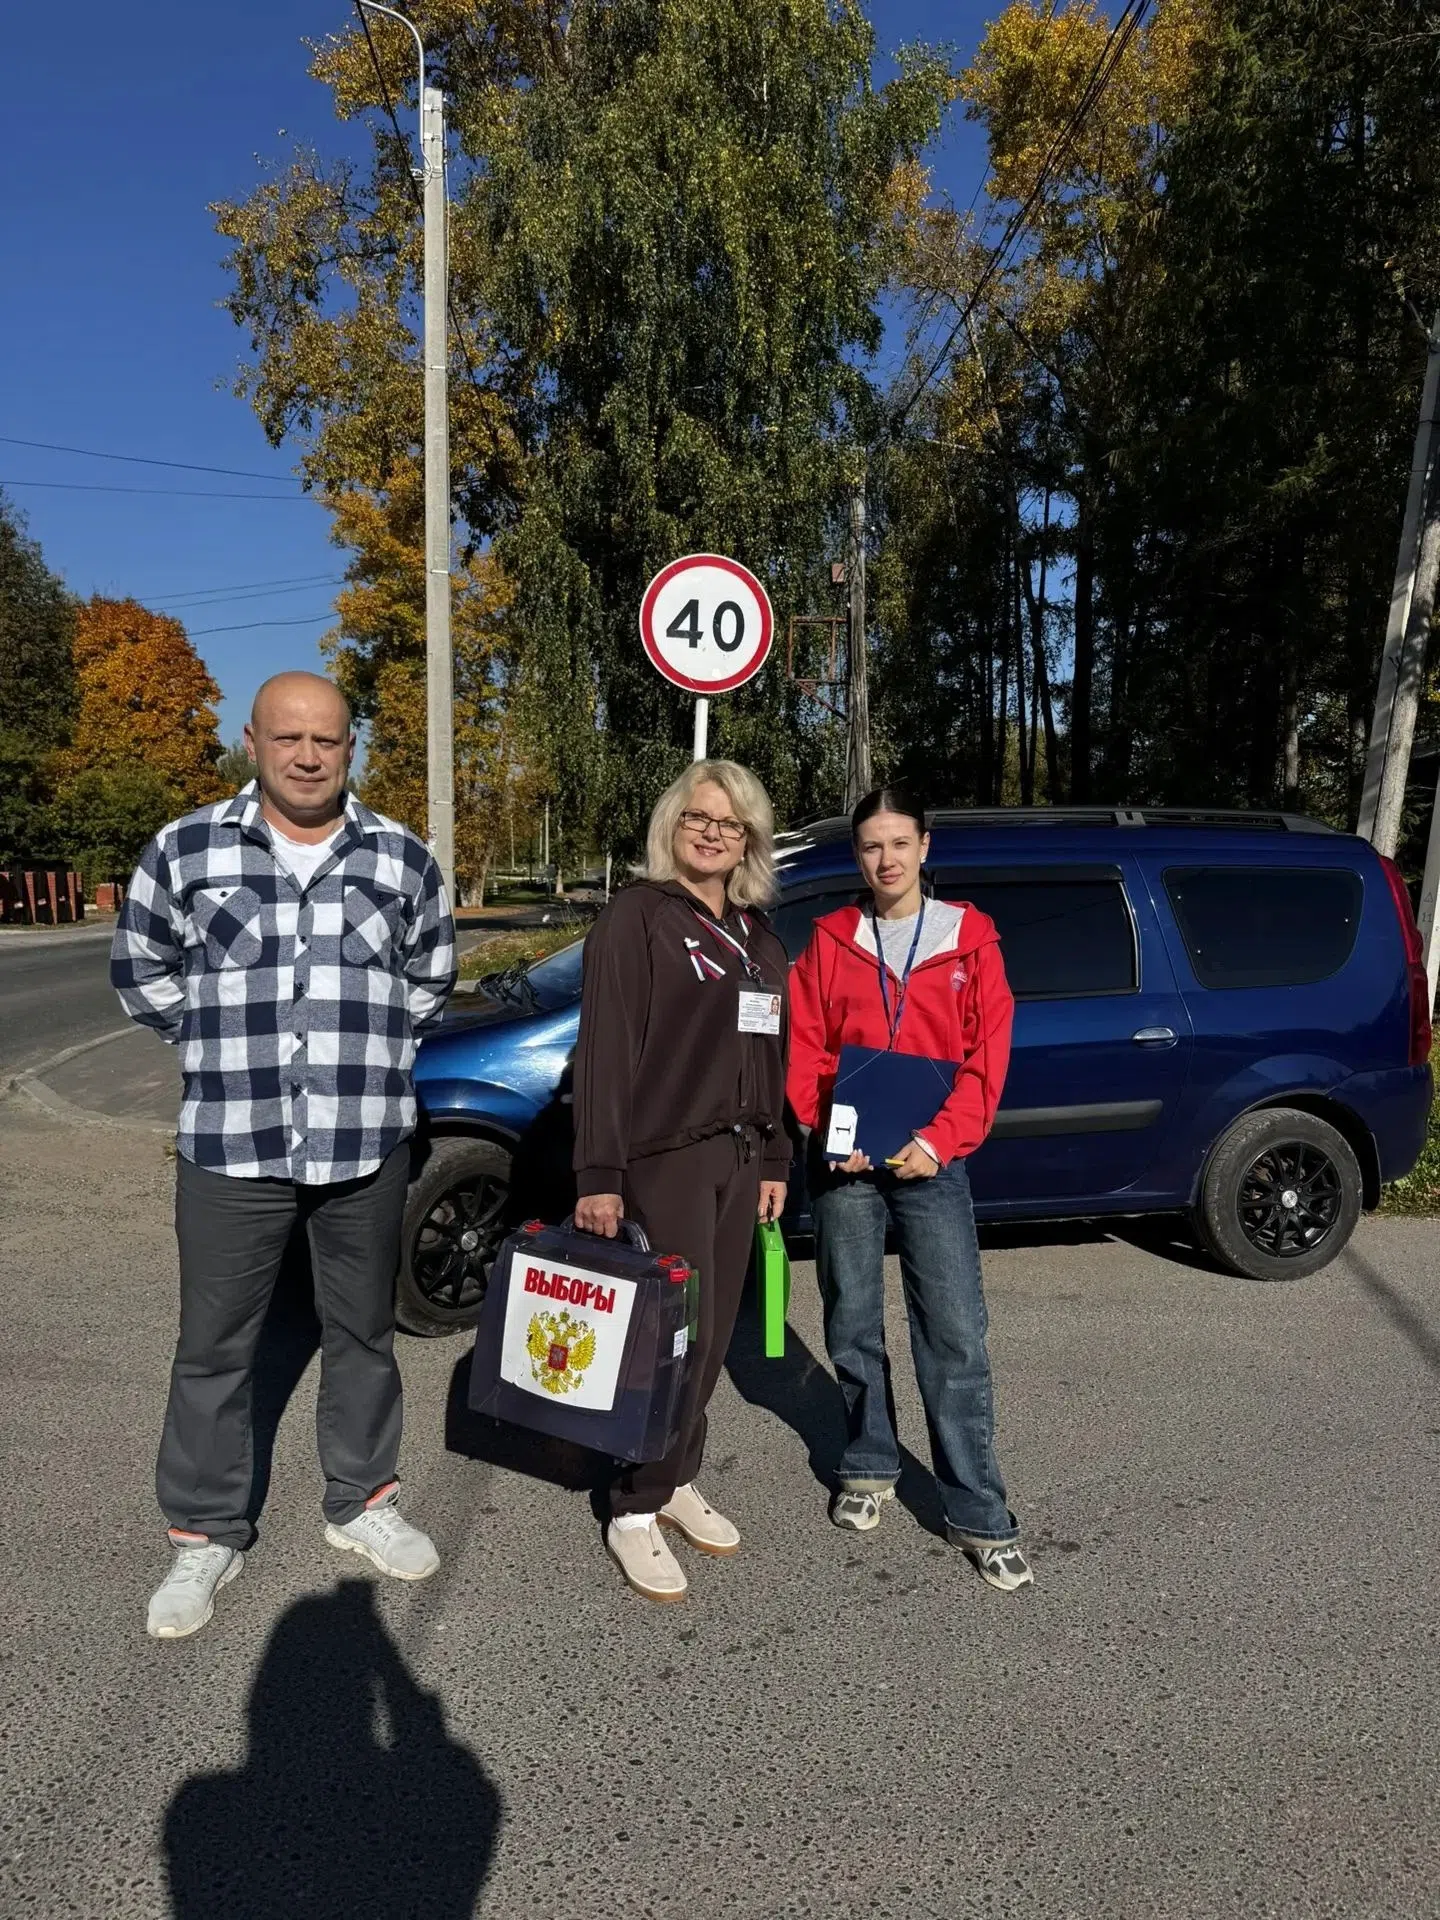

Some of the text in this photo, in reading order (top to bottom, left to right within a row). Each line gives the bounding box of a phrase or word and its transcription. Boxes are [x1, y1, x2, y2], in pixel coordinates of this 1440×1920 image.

[666, 599, 745, 652] 40
[835, 1126, 851, 1135] 1
[524, 1267, 616, 1313] ВЫБОРЫ
